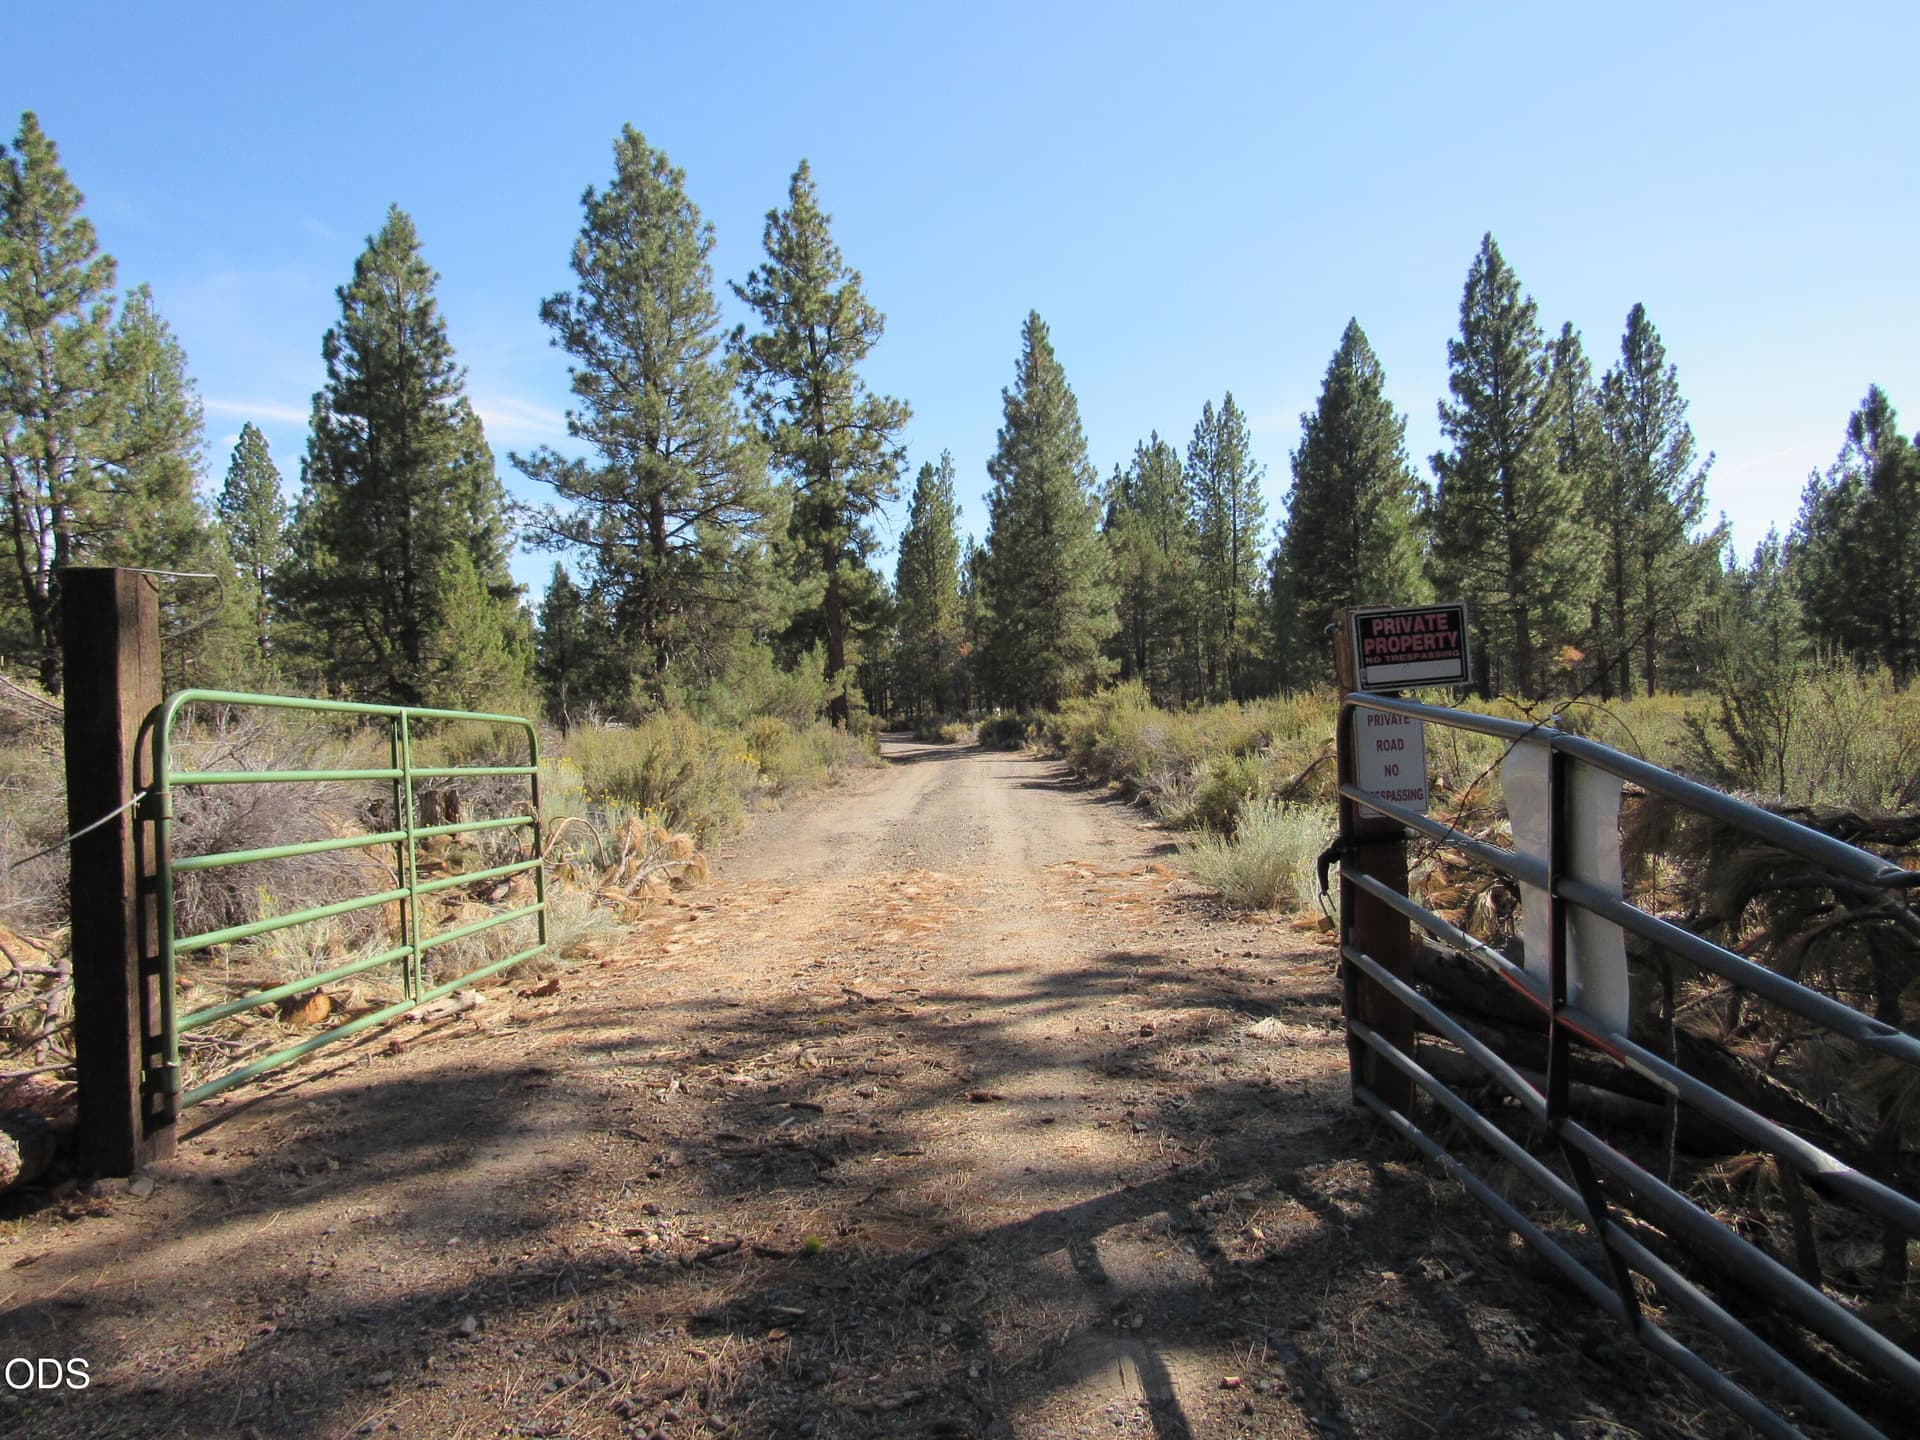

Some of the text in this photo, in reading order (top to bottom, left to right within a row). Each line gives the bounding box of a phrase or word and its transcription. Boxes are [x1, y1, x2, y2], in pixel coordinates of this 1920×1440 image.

[1371, 613, 1449, 636] PRIVATE
[1363, 632, 1458, 655] PROPERTY
[1365, 649, 1461, 664] NO TRESPASSING
[1376, 738, 1405, 753] ROAD
[1384, 764, 1399, 777] NO
